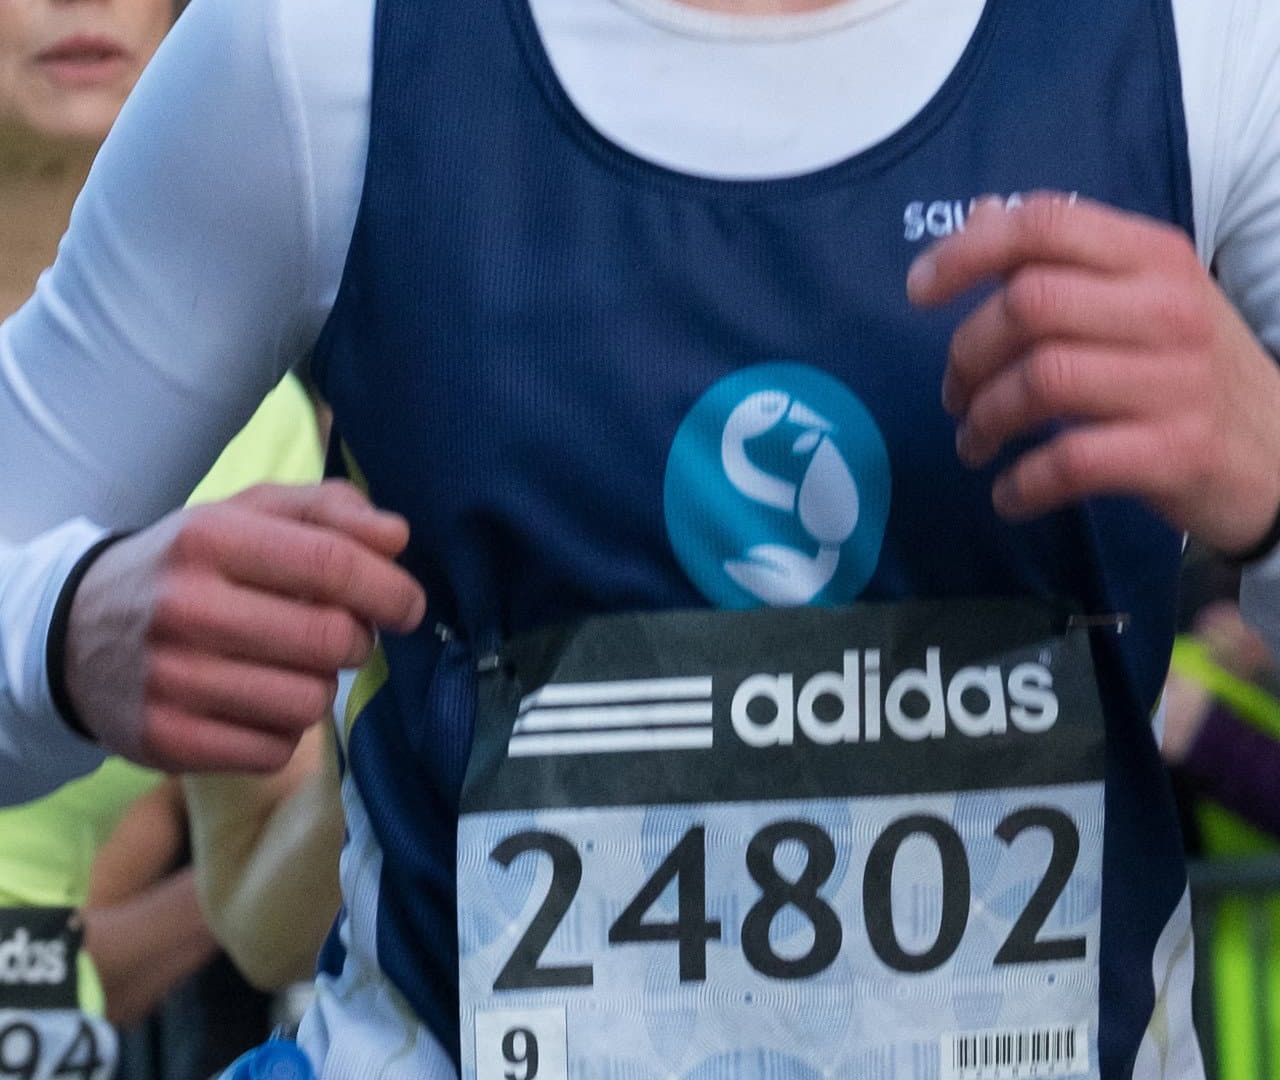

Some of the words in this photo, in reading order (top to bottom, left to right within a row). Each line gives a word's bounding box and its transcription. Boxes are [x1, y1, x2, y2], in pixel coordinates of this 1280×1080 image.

[730, 646, 1060, 749] adidas
[488, 803, 1087, 993] 24802
[501, 1025, 539, 1080] 9
